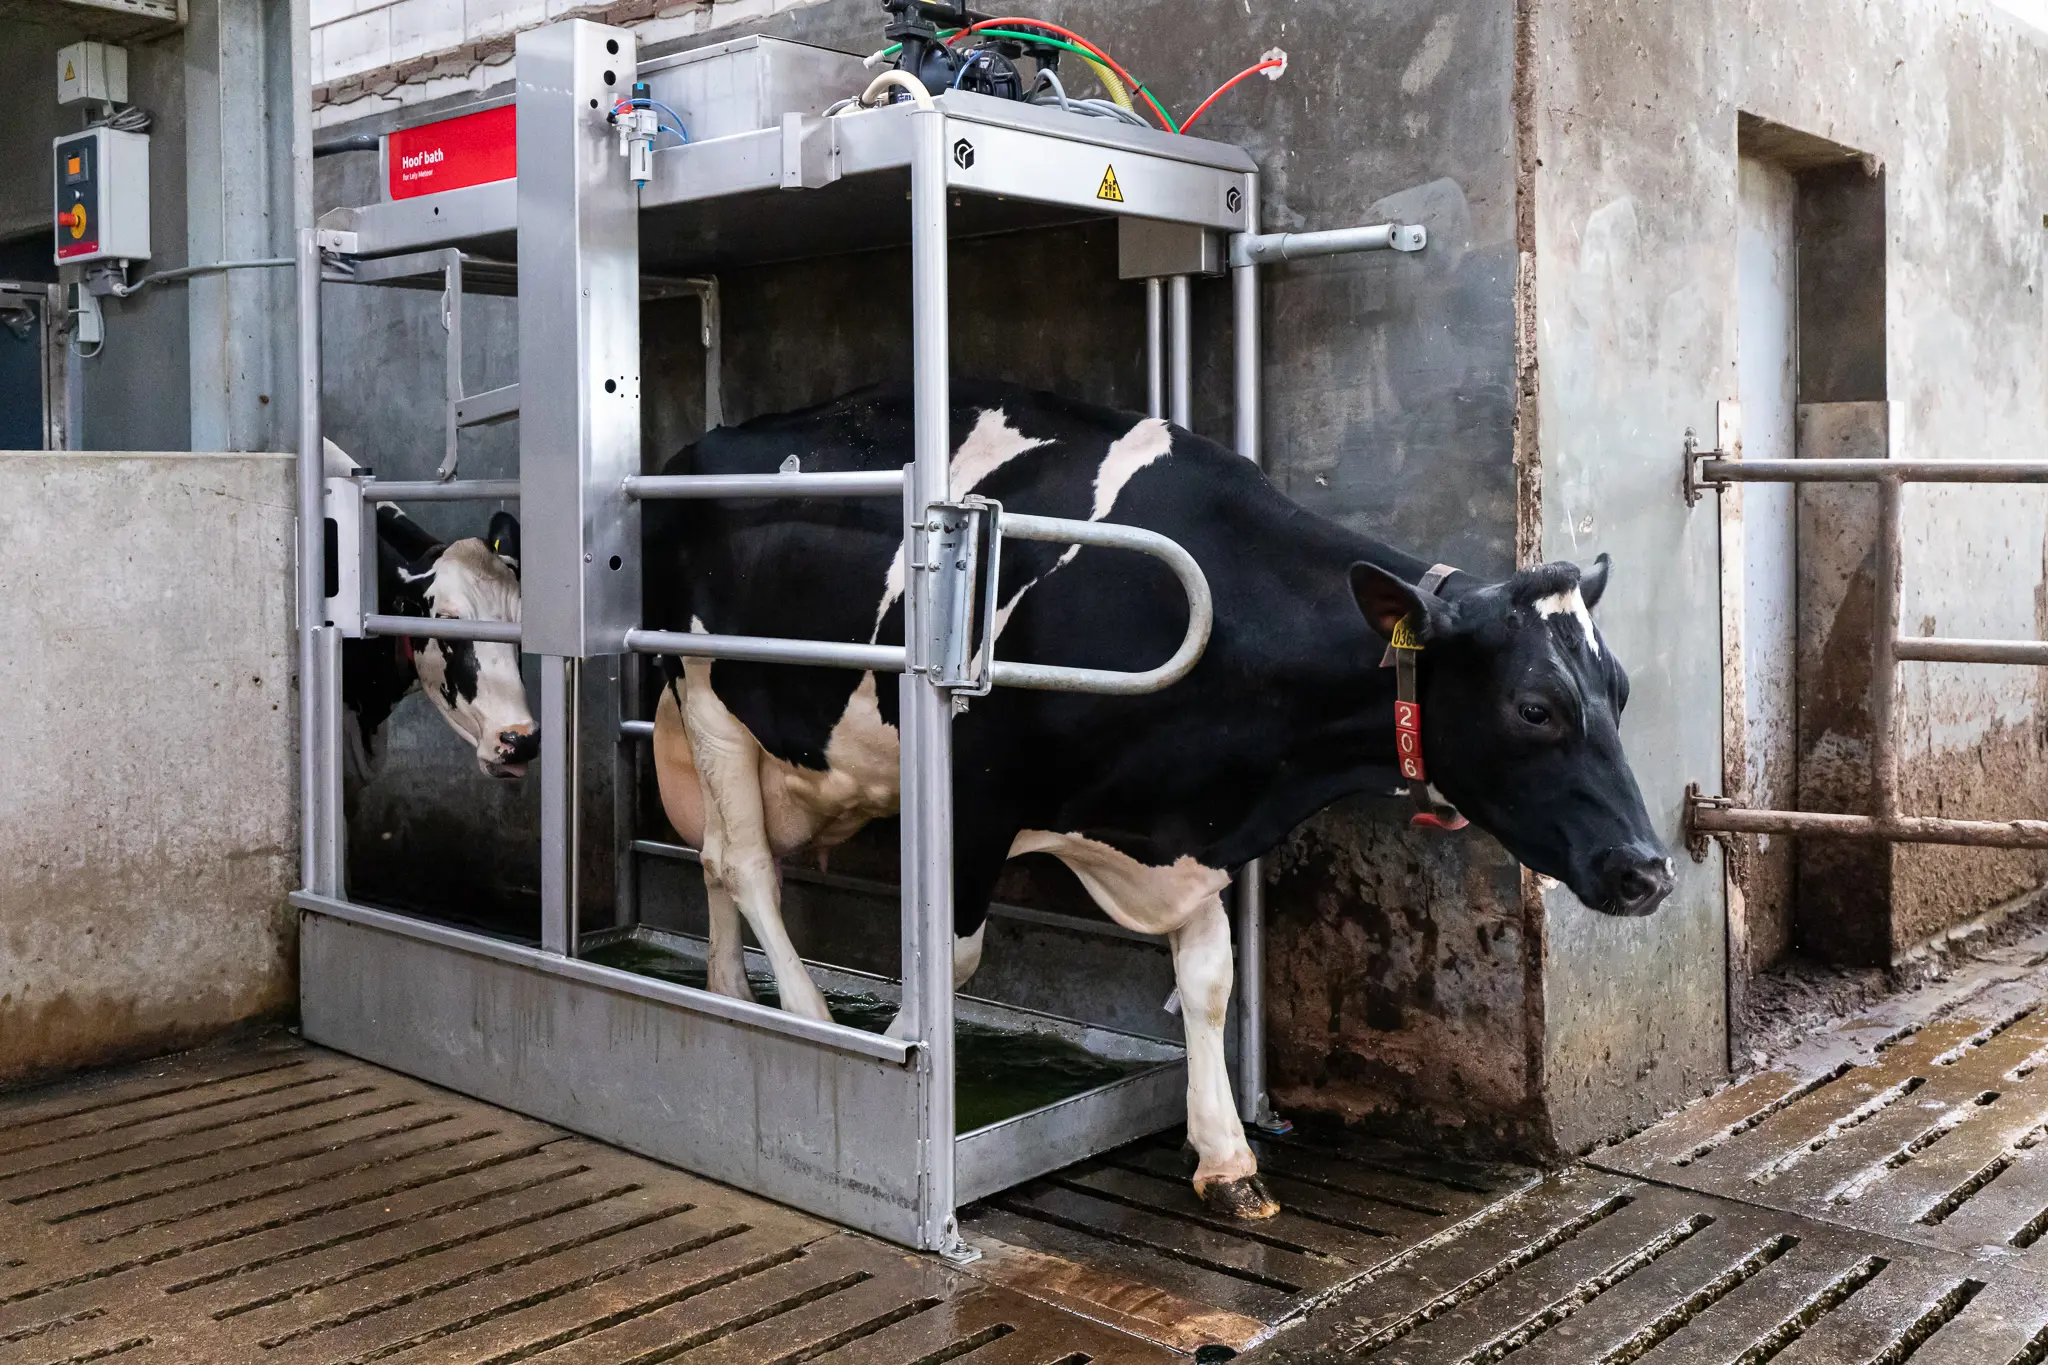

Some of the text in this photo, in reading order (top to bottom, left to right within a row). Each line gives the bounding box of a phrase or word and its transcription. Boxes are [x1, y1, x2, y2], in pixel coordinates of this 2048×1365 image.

[402, 148, 444, 169] Hoof bath
[402, 173, 410, 181] for
[1399, 705, 1417, 777] 206
